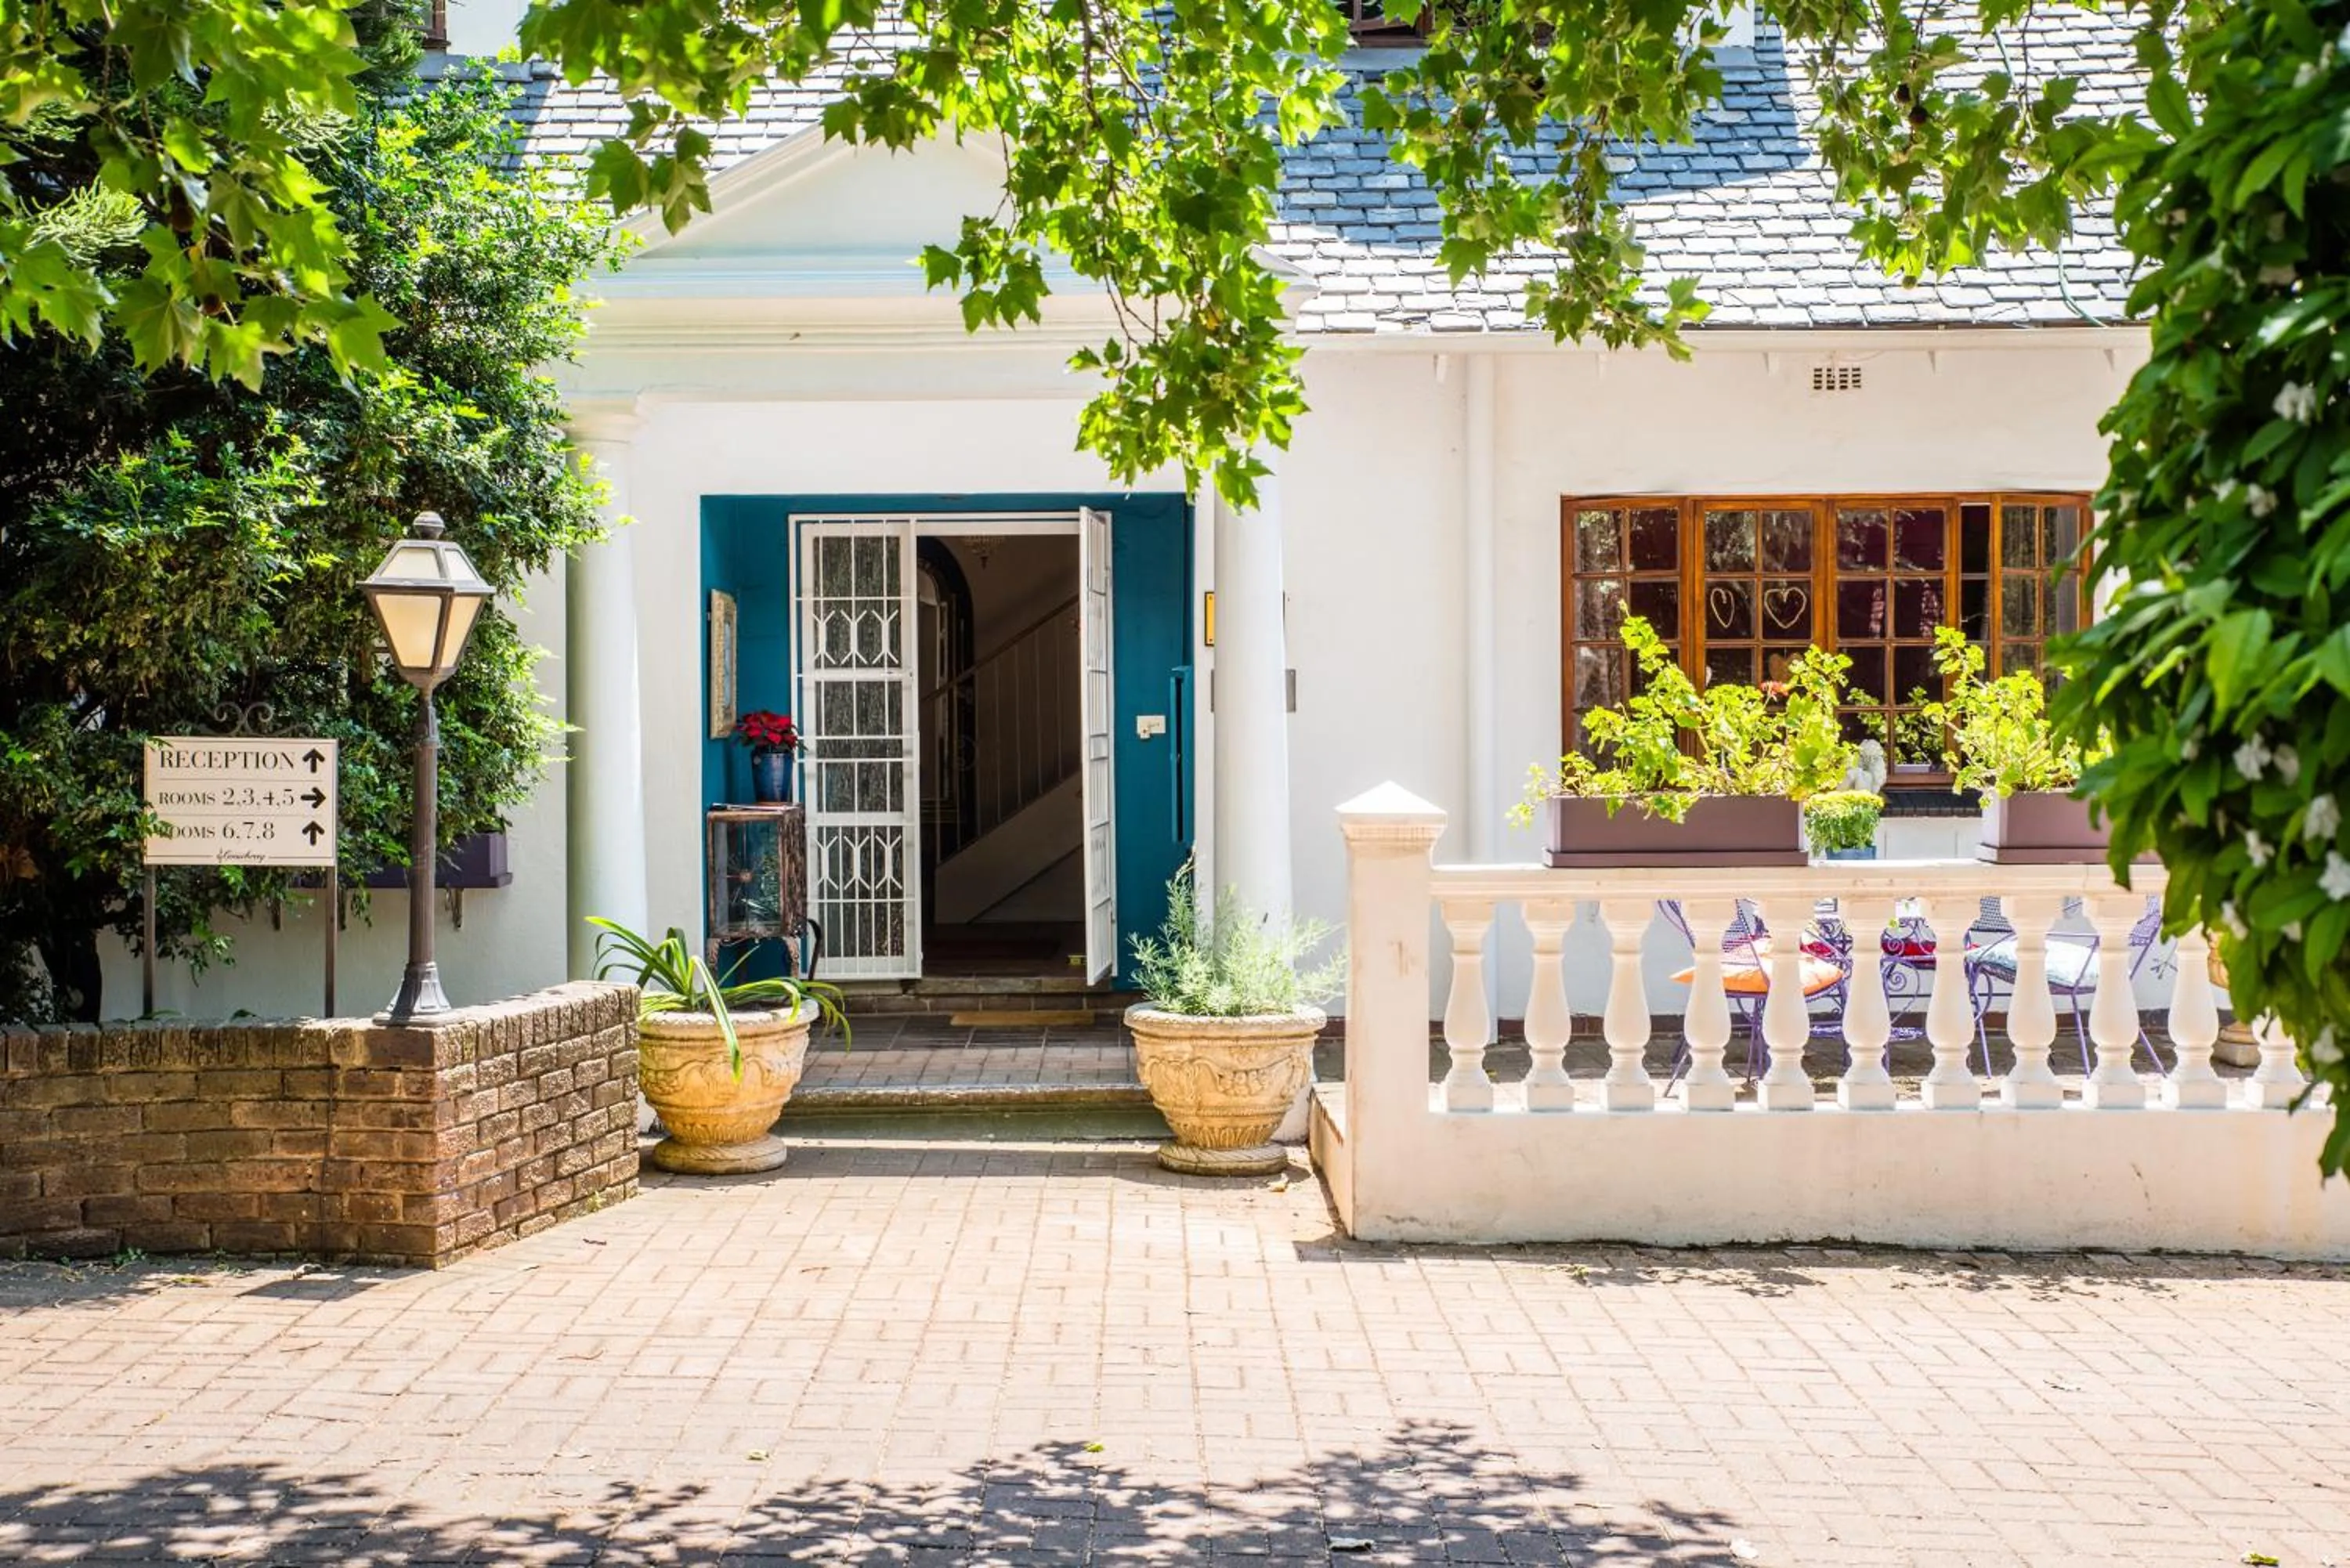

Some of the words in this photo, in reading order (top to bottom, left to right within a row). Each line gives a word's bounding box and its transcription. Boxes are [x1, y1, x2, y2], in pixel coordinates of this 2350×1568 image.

[159, 750, 295, 768] RECEPTION
[158, 792, 215, 804] ROOMS
[160, 826, 215, 838] OOMS
